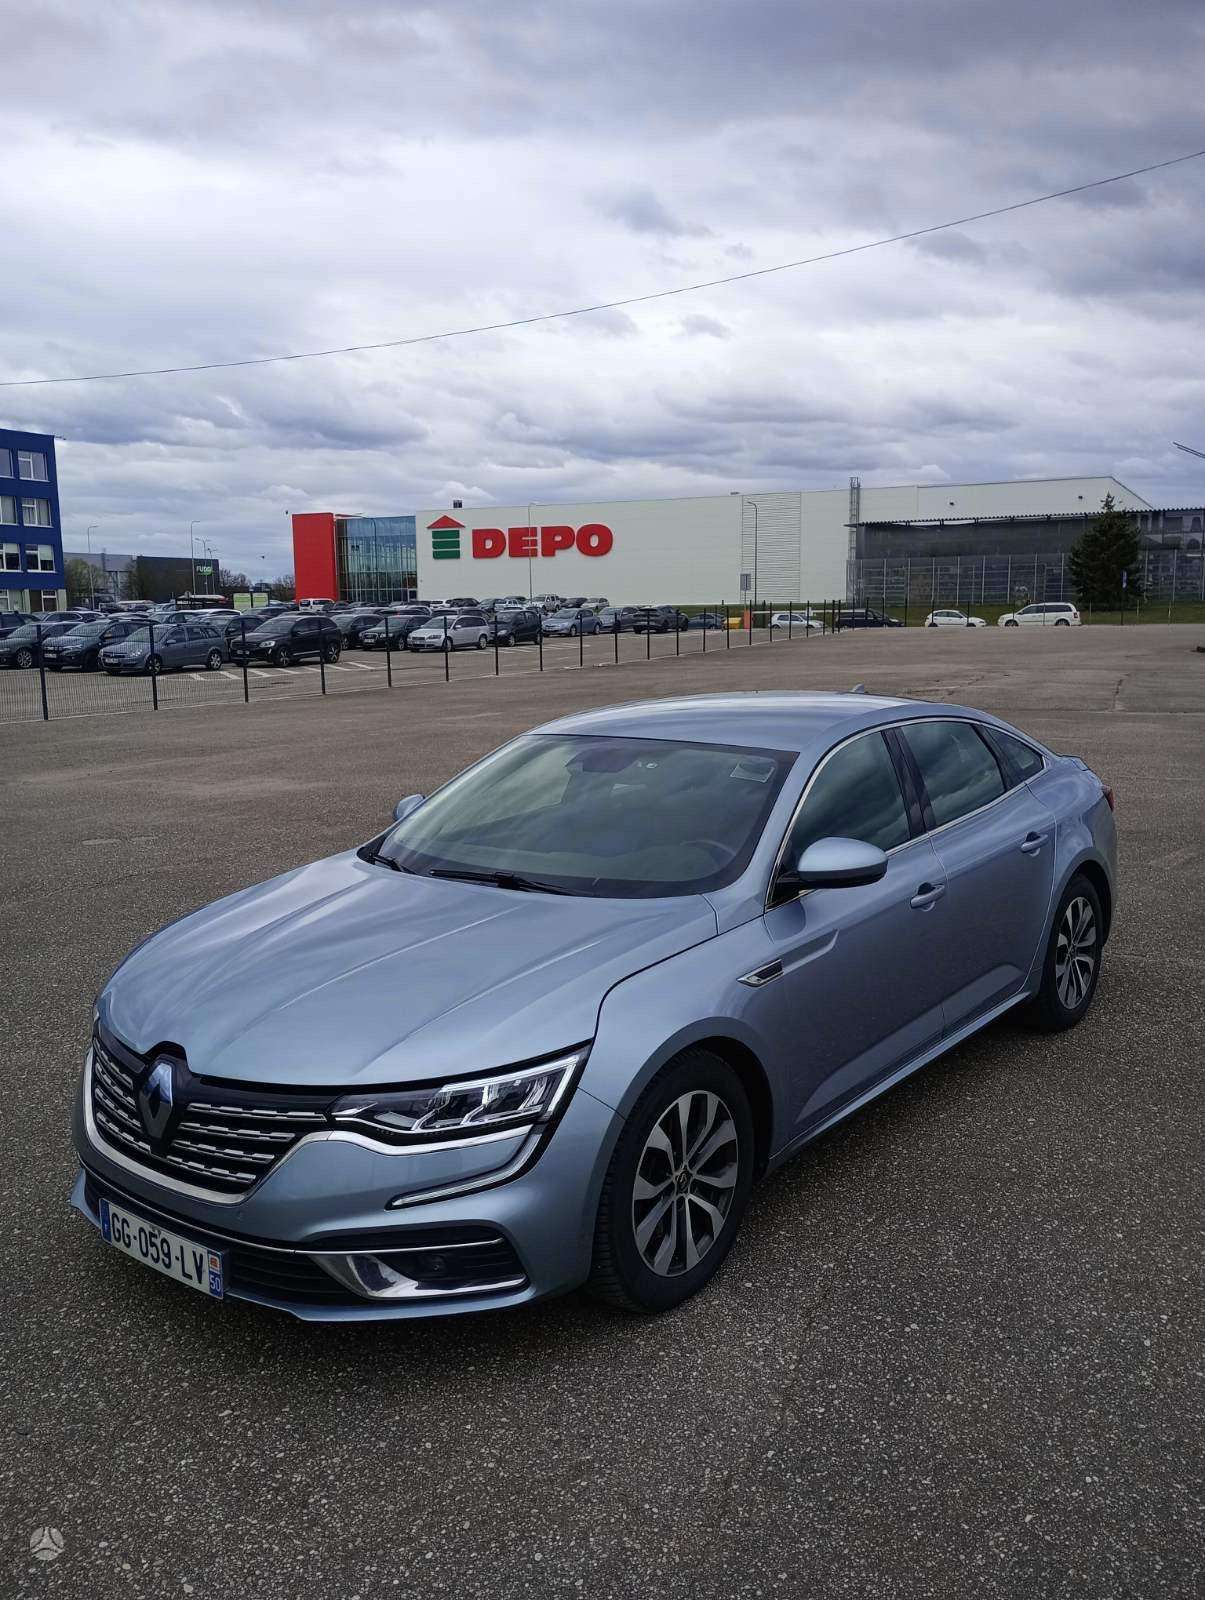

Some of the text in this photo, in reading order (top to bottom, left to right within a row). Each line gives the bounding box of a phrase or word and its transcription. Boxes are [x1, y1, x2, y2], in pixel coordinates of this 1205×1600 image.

[472, 524, 613, 559] DEPO
[112, 1212, 204, 1285] GG-059-LV
[209, 1275, 221, 1292] 50
